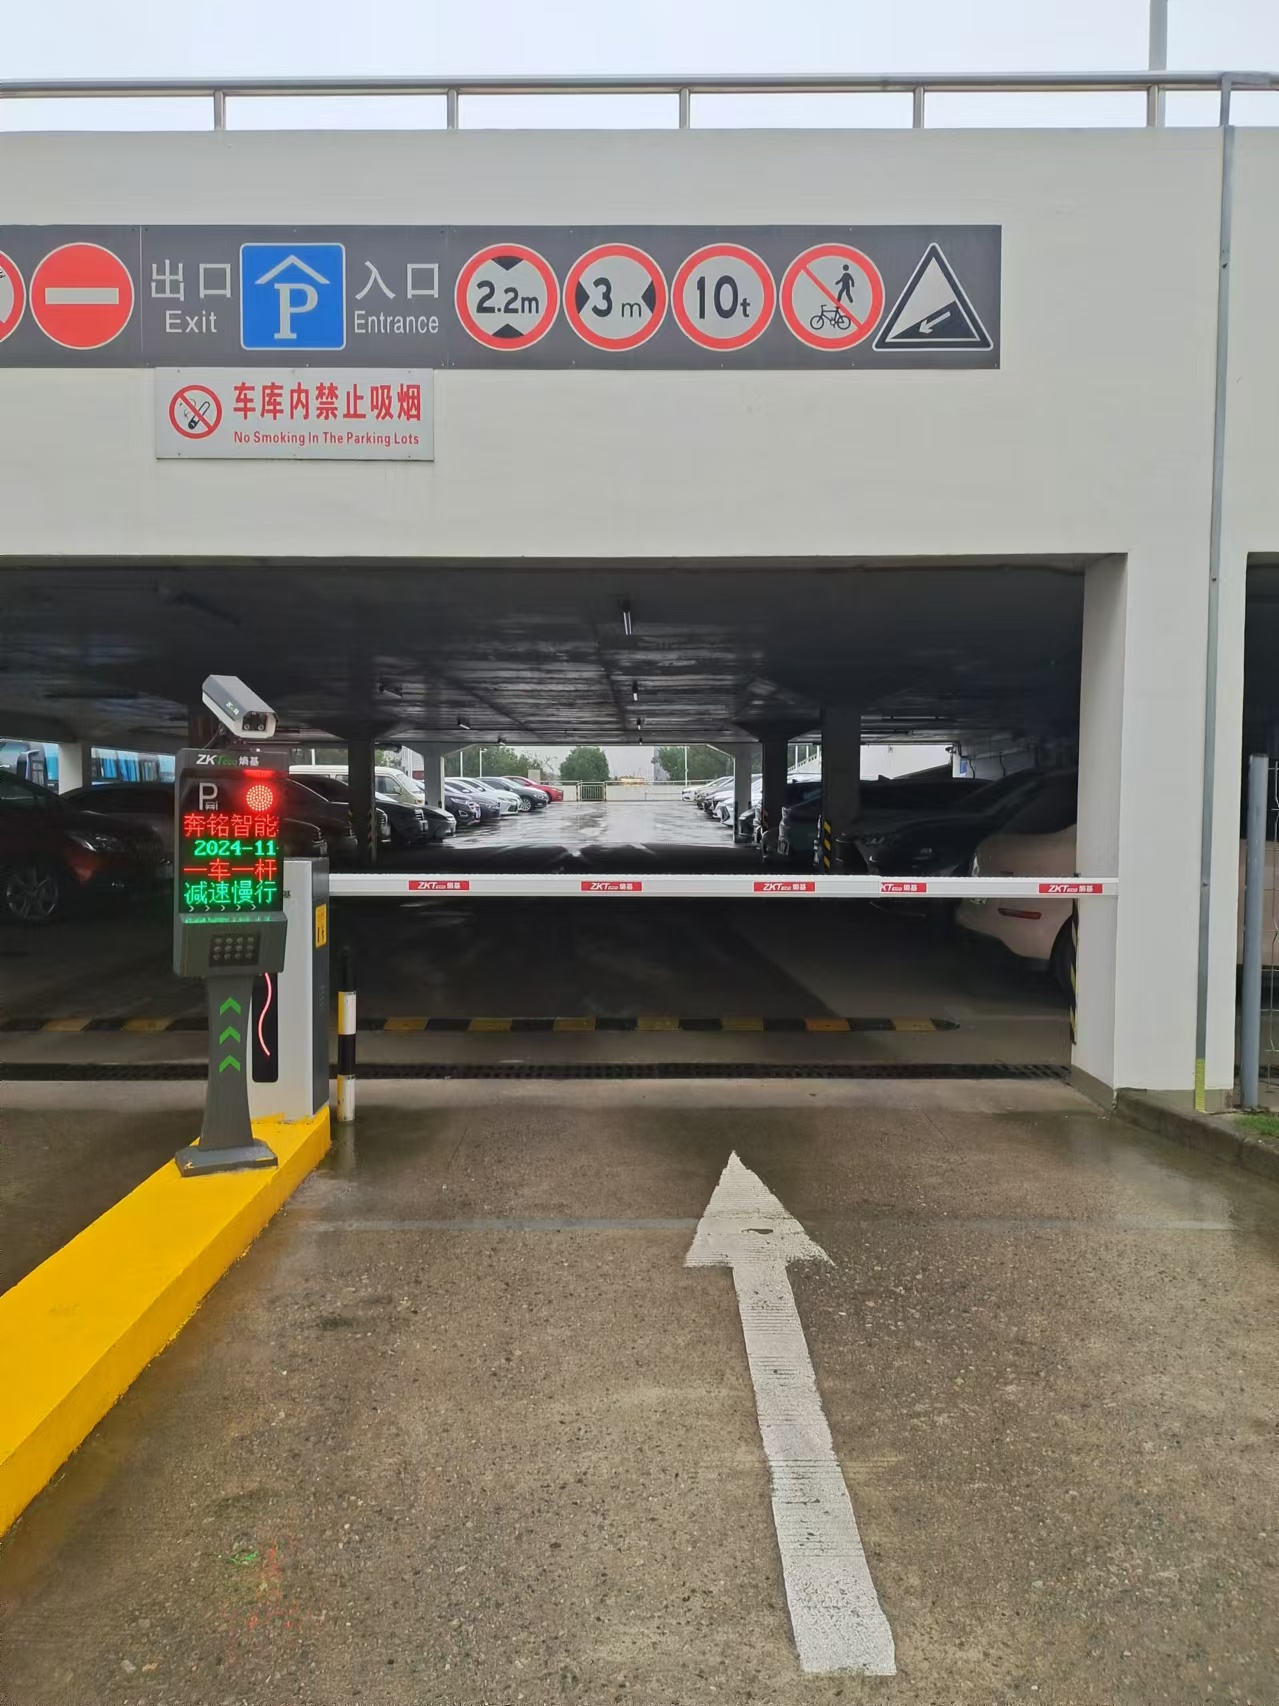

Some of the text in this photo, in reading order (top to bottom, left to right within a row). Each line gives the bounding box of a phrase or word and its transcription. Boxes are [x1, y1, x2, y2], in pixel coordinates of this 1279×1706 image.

[151, 259, 233, 302] 出口
[354, 260, 440, 300] 入口
[273, 282, 319, 340] P
[475, 280, 540, 315] 2.2m
[696, 274, 751, 320] 10t
[164, 310, 218, 334] Exit
[353, 310, 440, 334] Entrance
[232, 381, 421, 421] 车库内禁止吸烟
[233, 431, 420, 448] No Smoking In The Parking Lots
[193, 839, 277, 856] 2024-11
[183, 858, 278, 882] 一车一杆
[183, 879, 278, 905] 减速慢行
